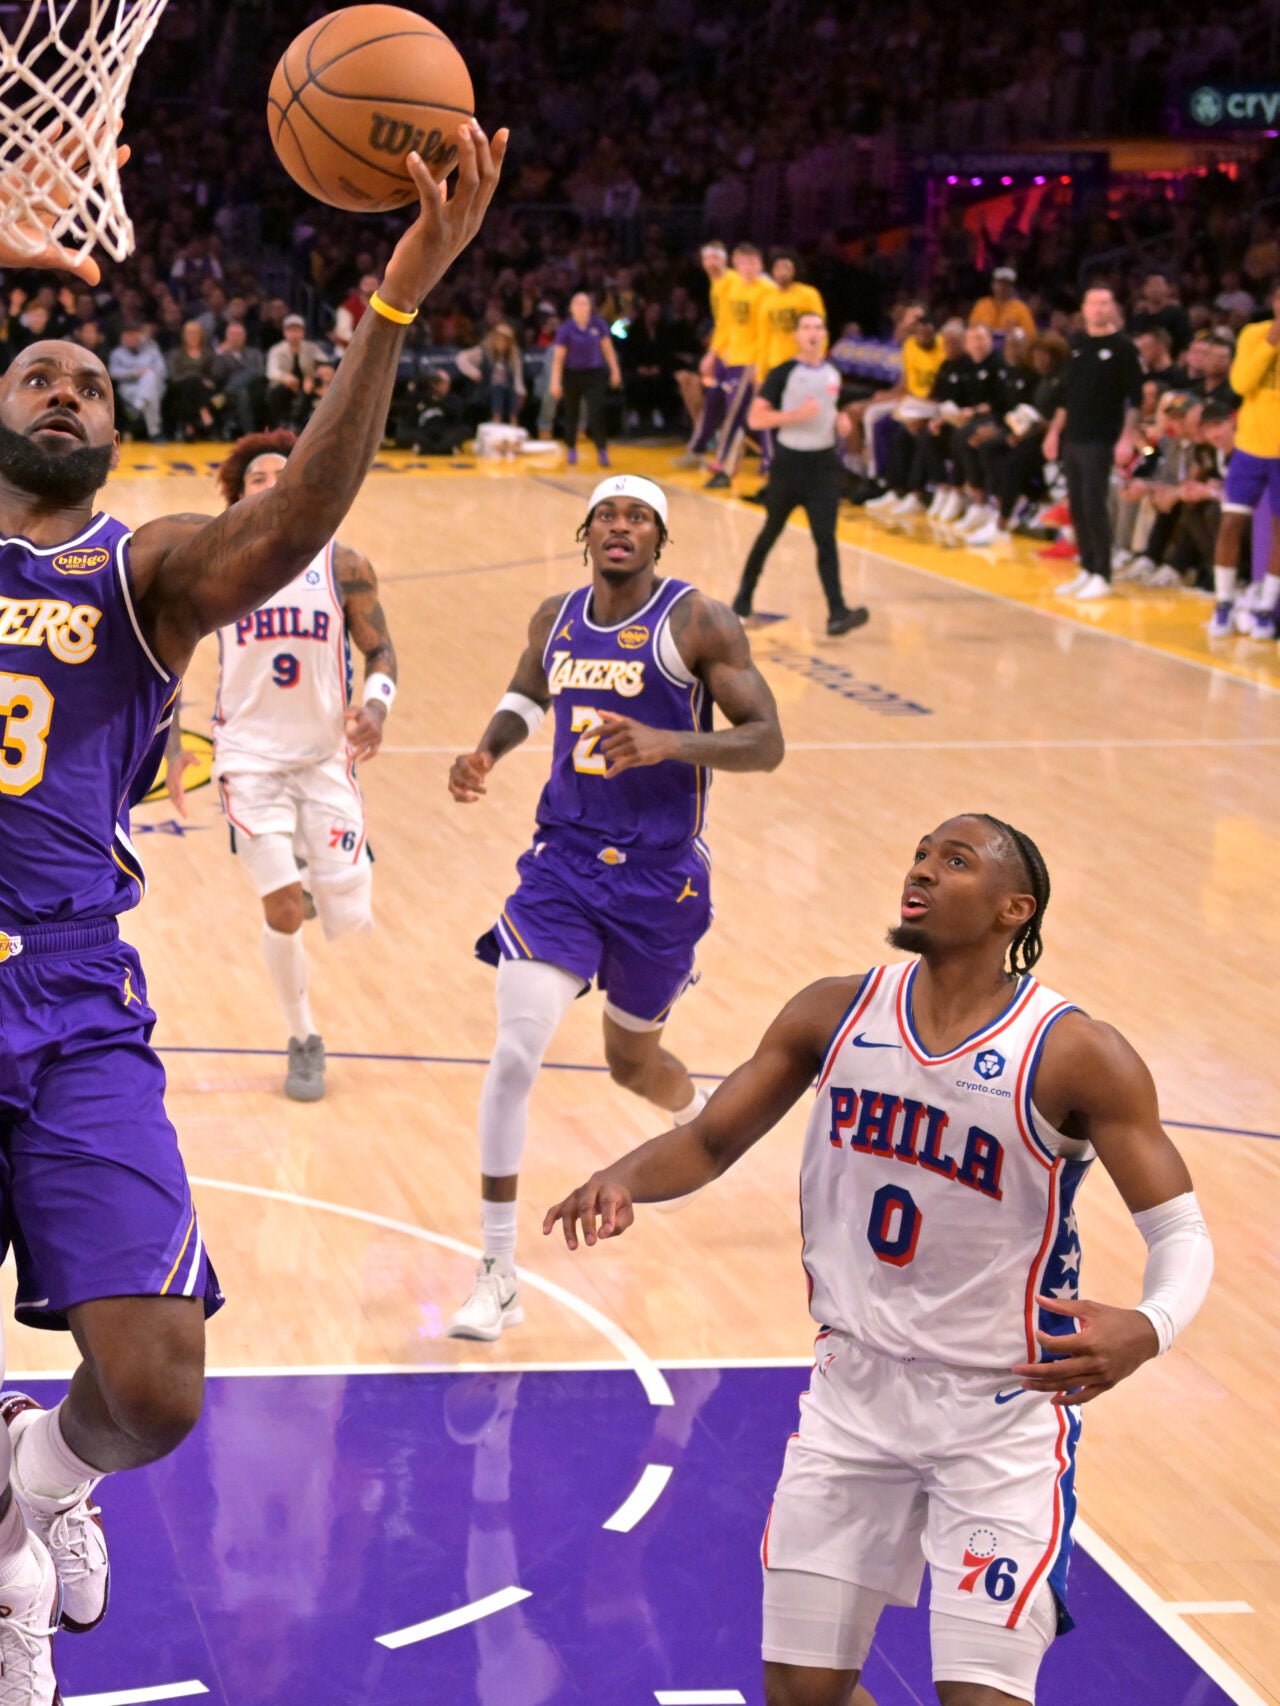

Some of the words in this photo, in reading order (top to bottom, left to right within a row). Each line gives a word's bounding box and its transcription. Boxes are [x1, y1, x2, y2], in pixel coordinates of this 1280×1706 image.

[369, 111, 458, 165] Wilso
[58, 555, 106, 566] bibigo
[235, 607, 329, 645] PHILA
[272, 653, 300, 689] 9
[548, 651, 645, 697] LAKERS
[328, 828, 356, 852] 76
[956, 1080, 1011, 1098] crypto.com
[829, 1086, 1005, 1201] PHILA
[867, 1184, 923, 1268] 0
[958, 1549, 1018, 1602] 76
